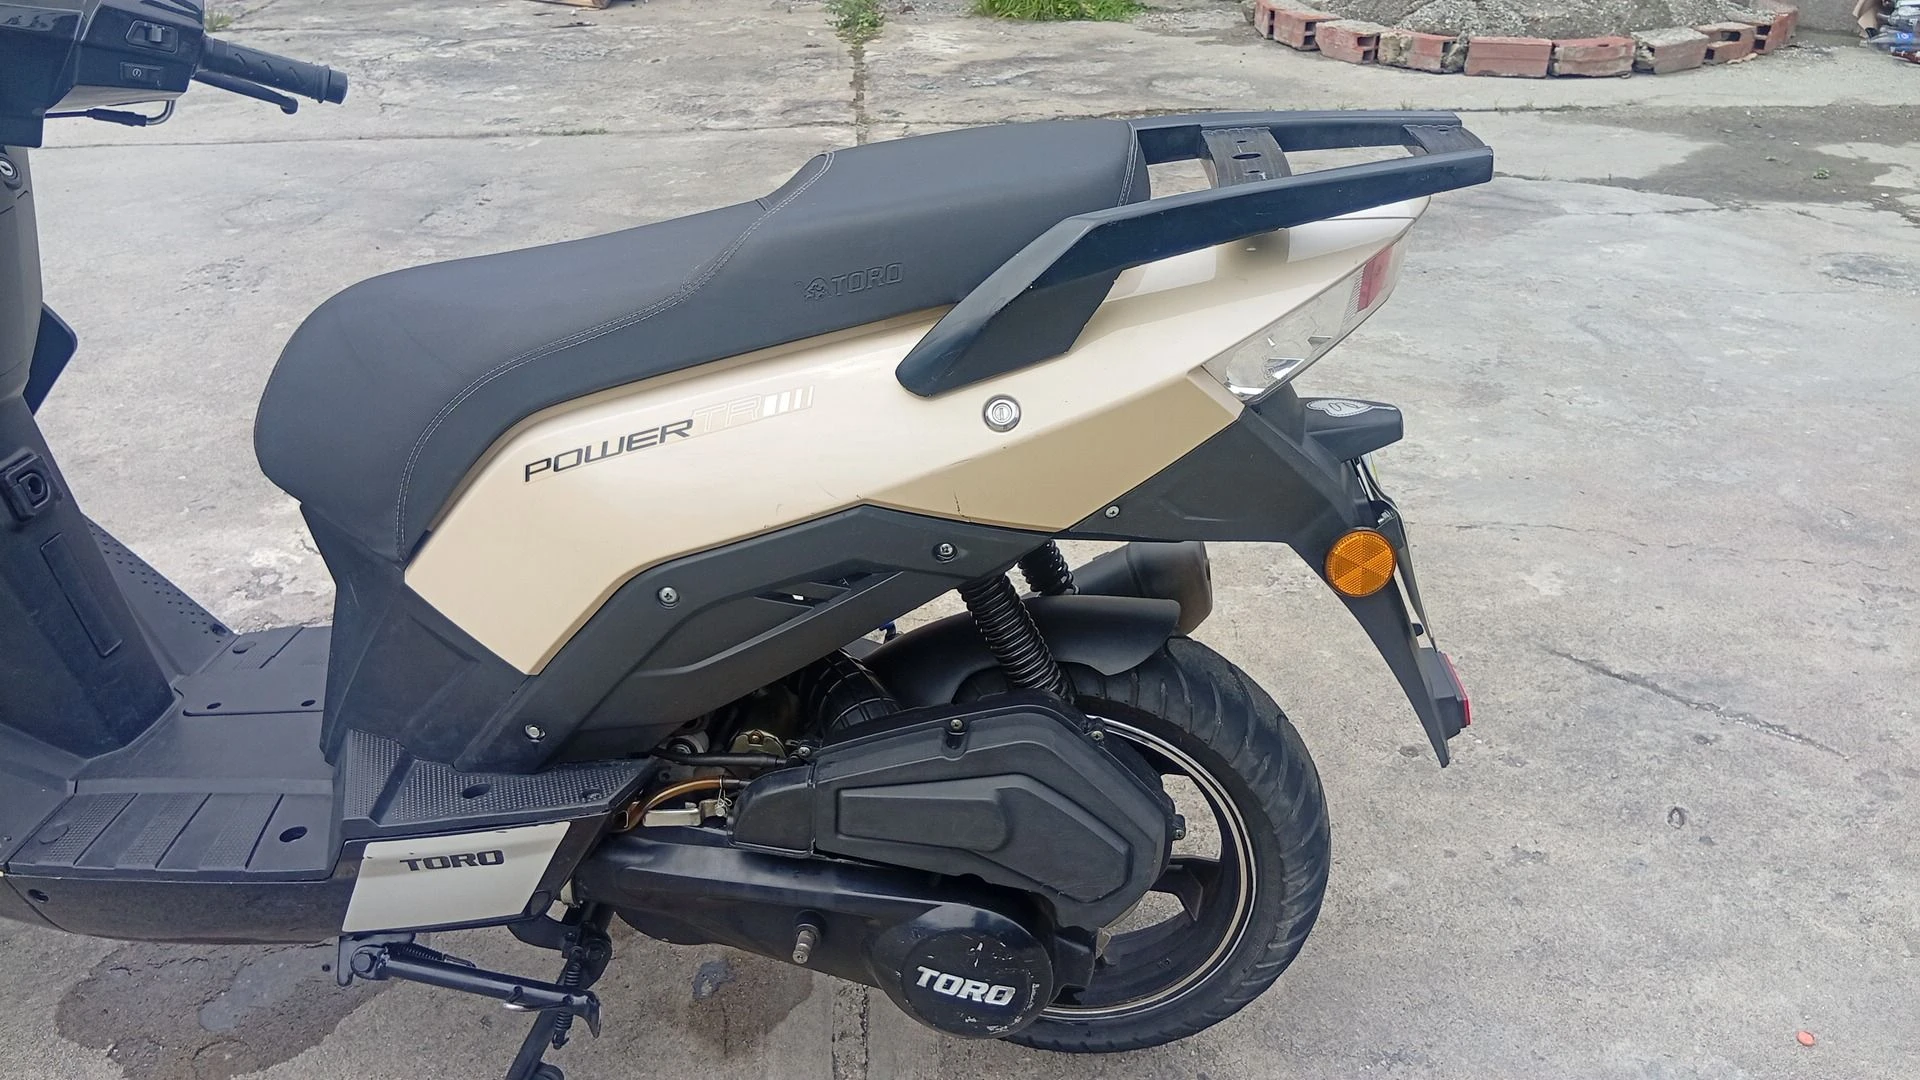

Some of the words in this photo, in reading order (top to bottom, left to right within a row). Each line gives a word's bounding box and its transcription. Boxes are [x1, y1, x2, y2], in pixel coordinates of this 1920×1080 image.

[831, 262, 903, 297] TORO
[524, 418, 694, 483] POWER
[399, 849, 505, 872] TORO
[916, 965, 1016, 1006] TORO
